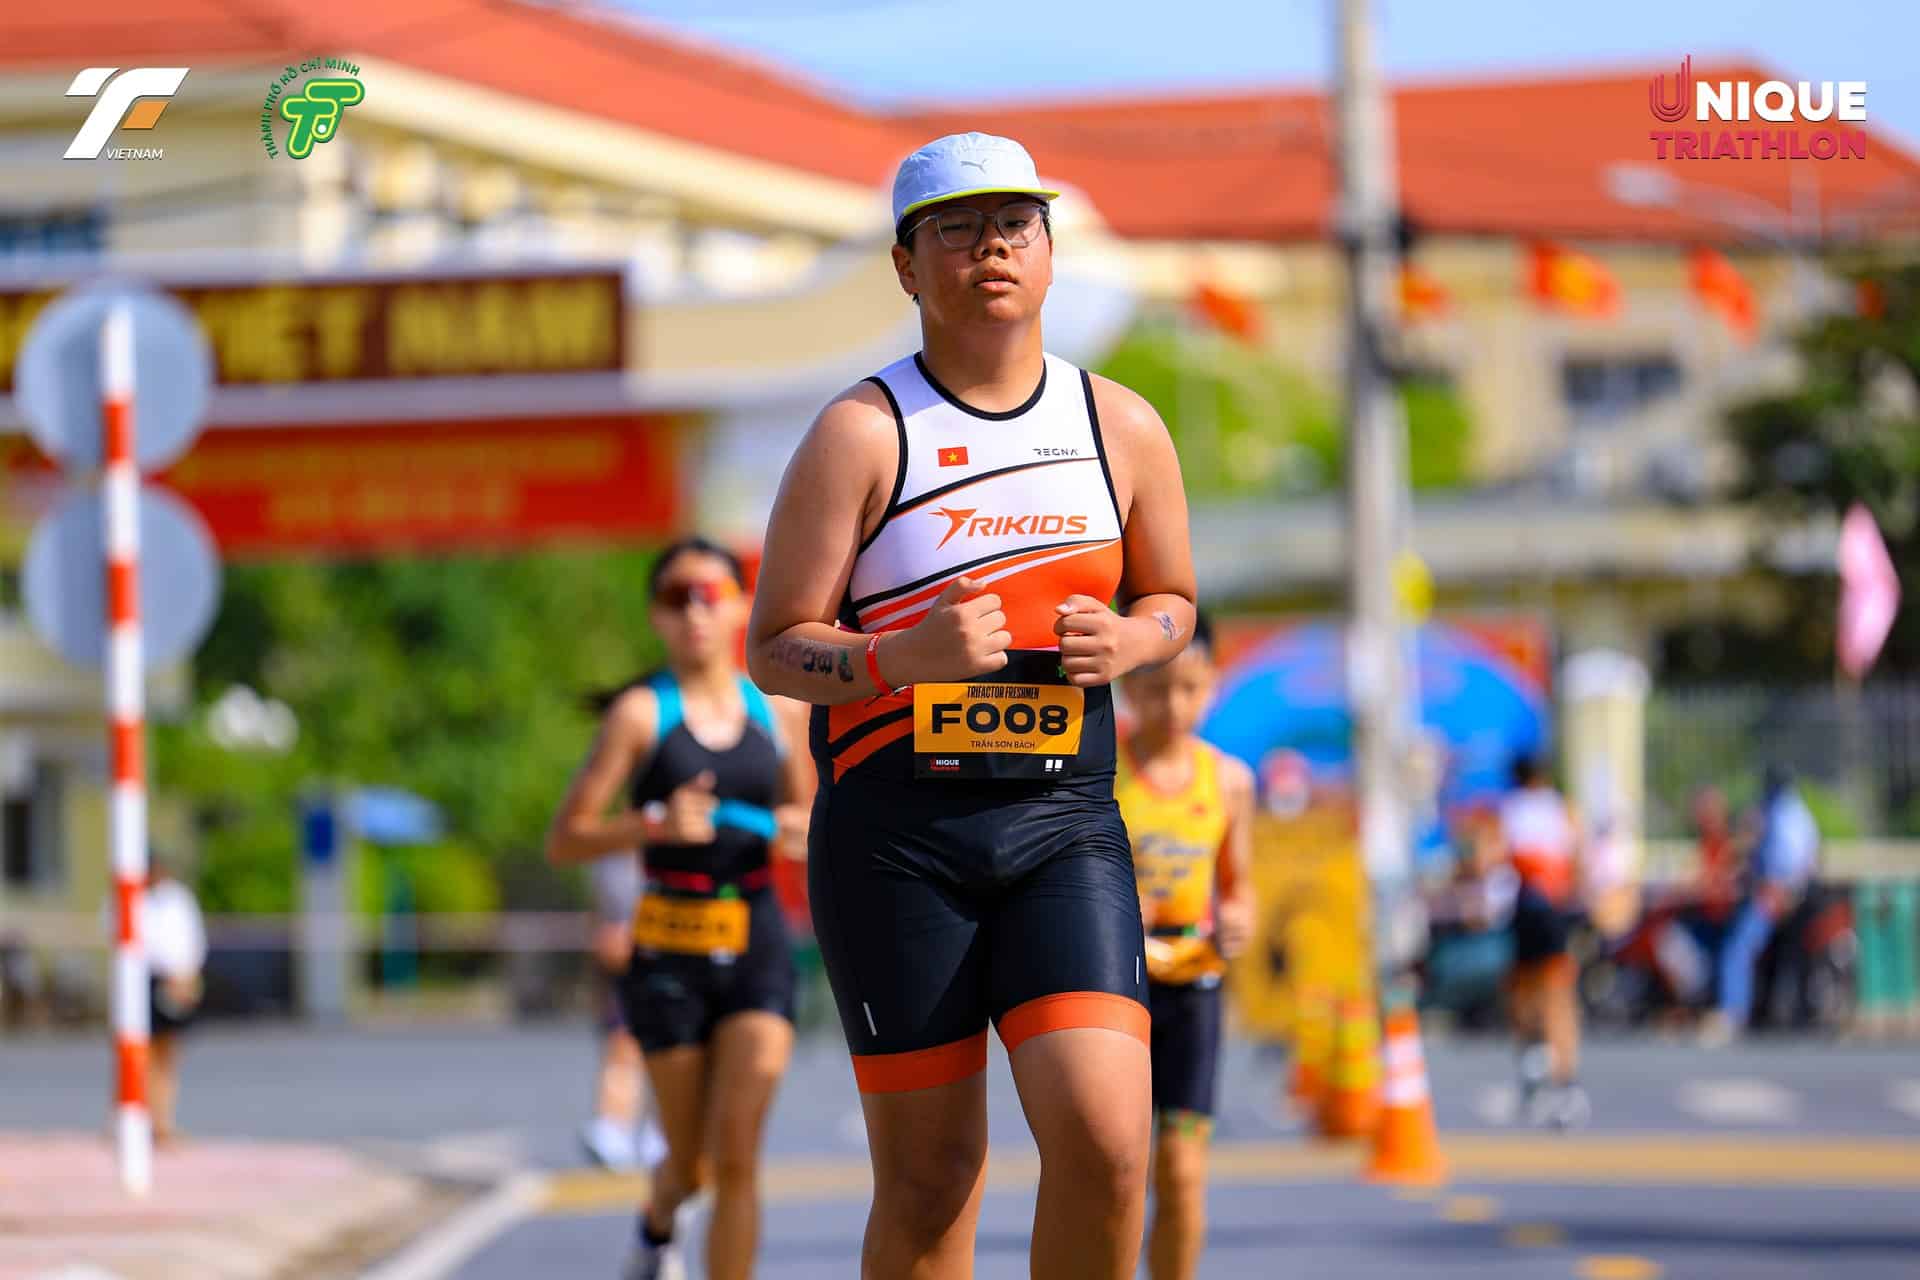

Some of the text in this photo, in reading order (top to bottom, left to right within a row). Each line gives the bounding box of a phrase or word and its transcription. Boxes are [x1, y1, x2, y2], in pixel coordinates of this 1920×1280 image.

[1032, 447, 1079, 456] REGNA
[928, 506, 1088, 551] TRIKIDS
[967, 686, 1040, 700] TRIFACTOR FRESHMEN
[931, 703, 1069, 736] F008
